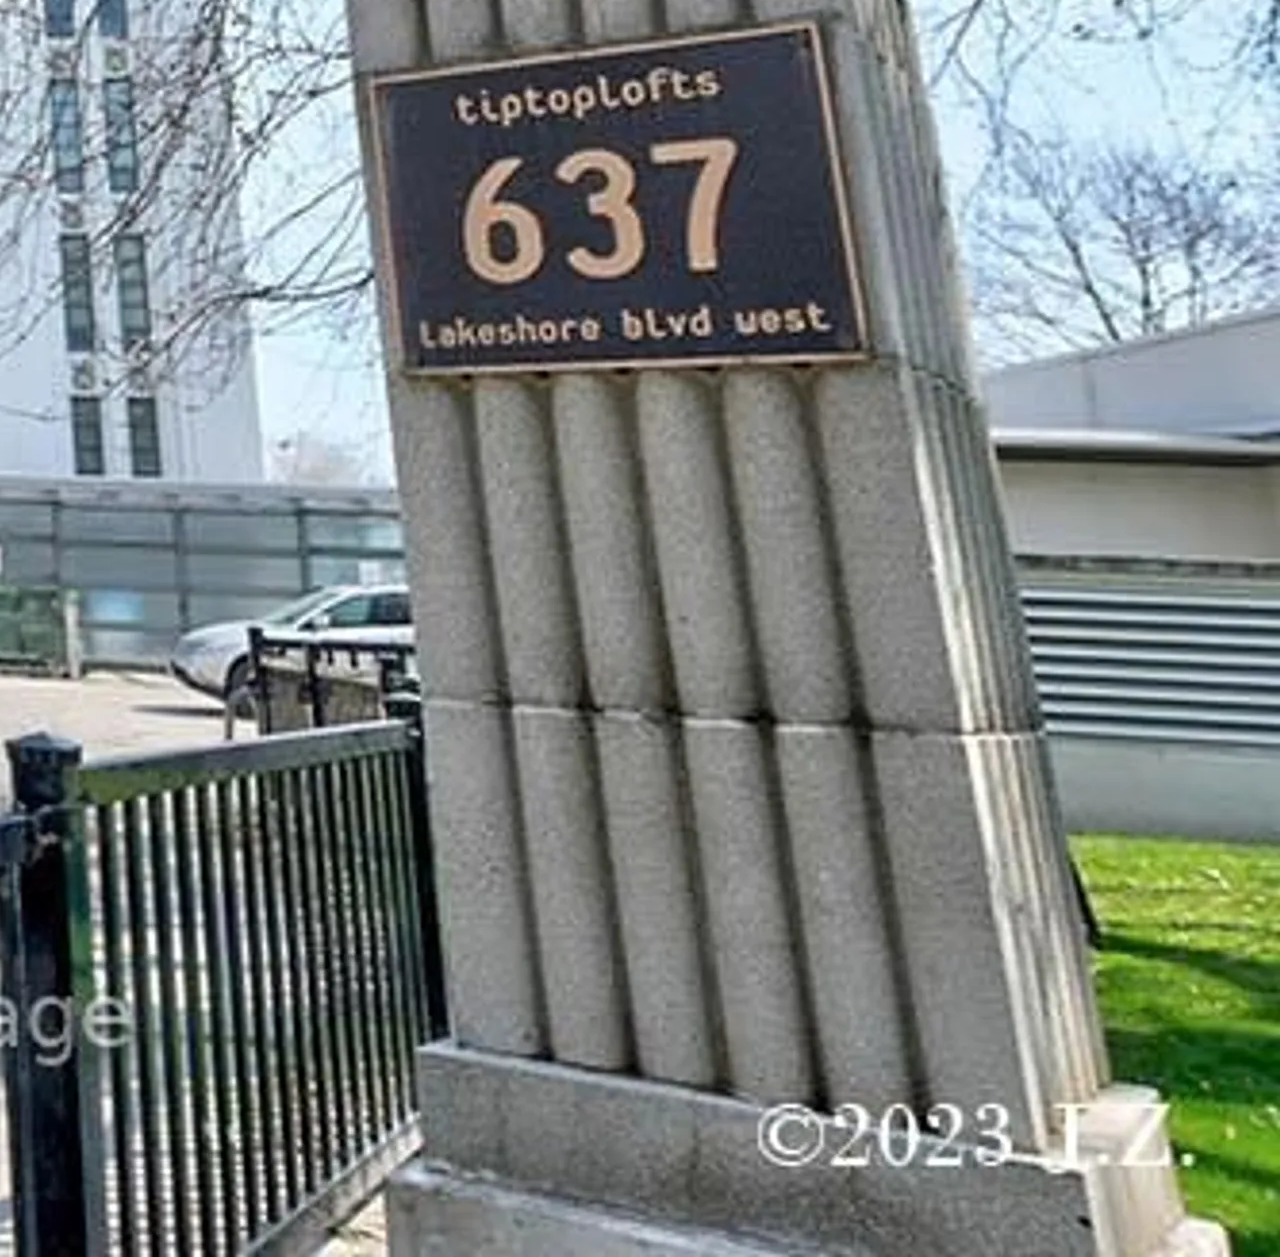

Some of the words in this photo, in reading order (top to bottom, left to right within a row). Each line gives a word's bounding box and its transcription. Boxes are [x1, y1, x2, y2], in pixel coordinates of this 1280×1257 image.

[455, 67, 723, 126] tiptoplofts
[462, 137, 738, 284] 637
[621, 304, 713, 341] blvd
[734, 302, 832, 334] west
